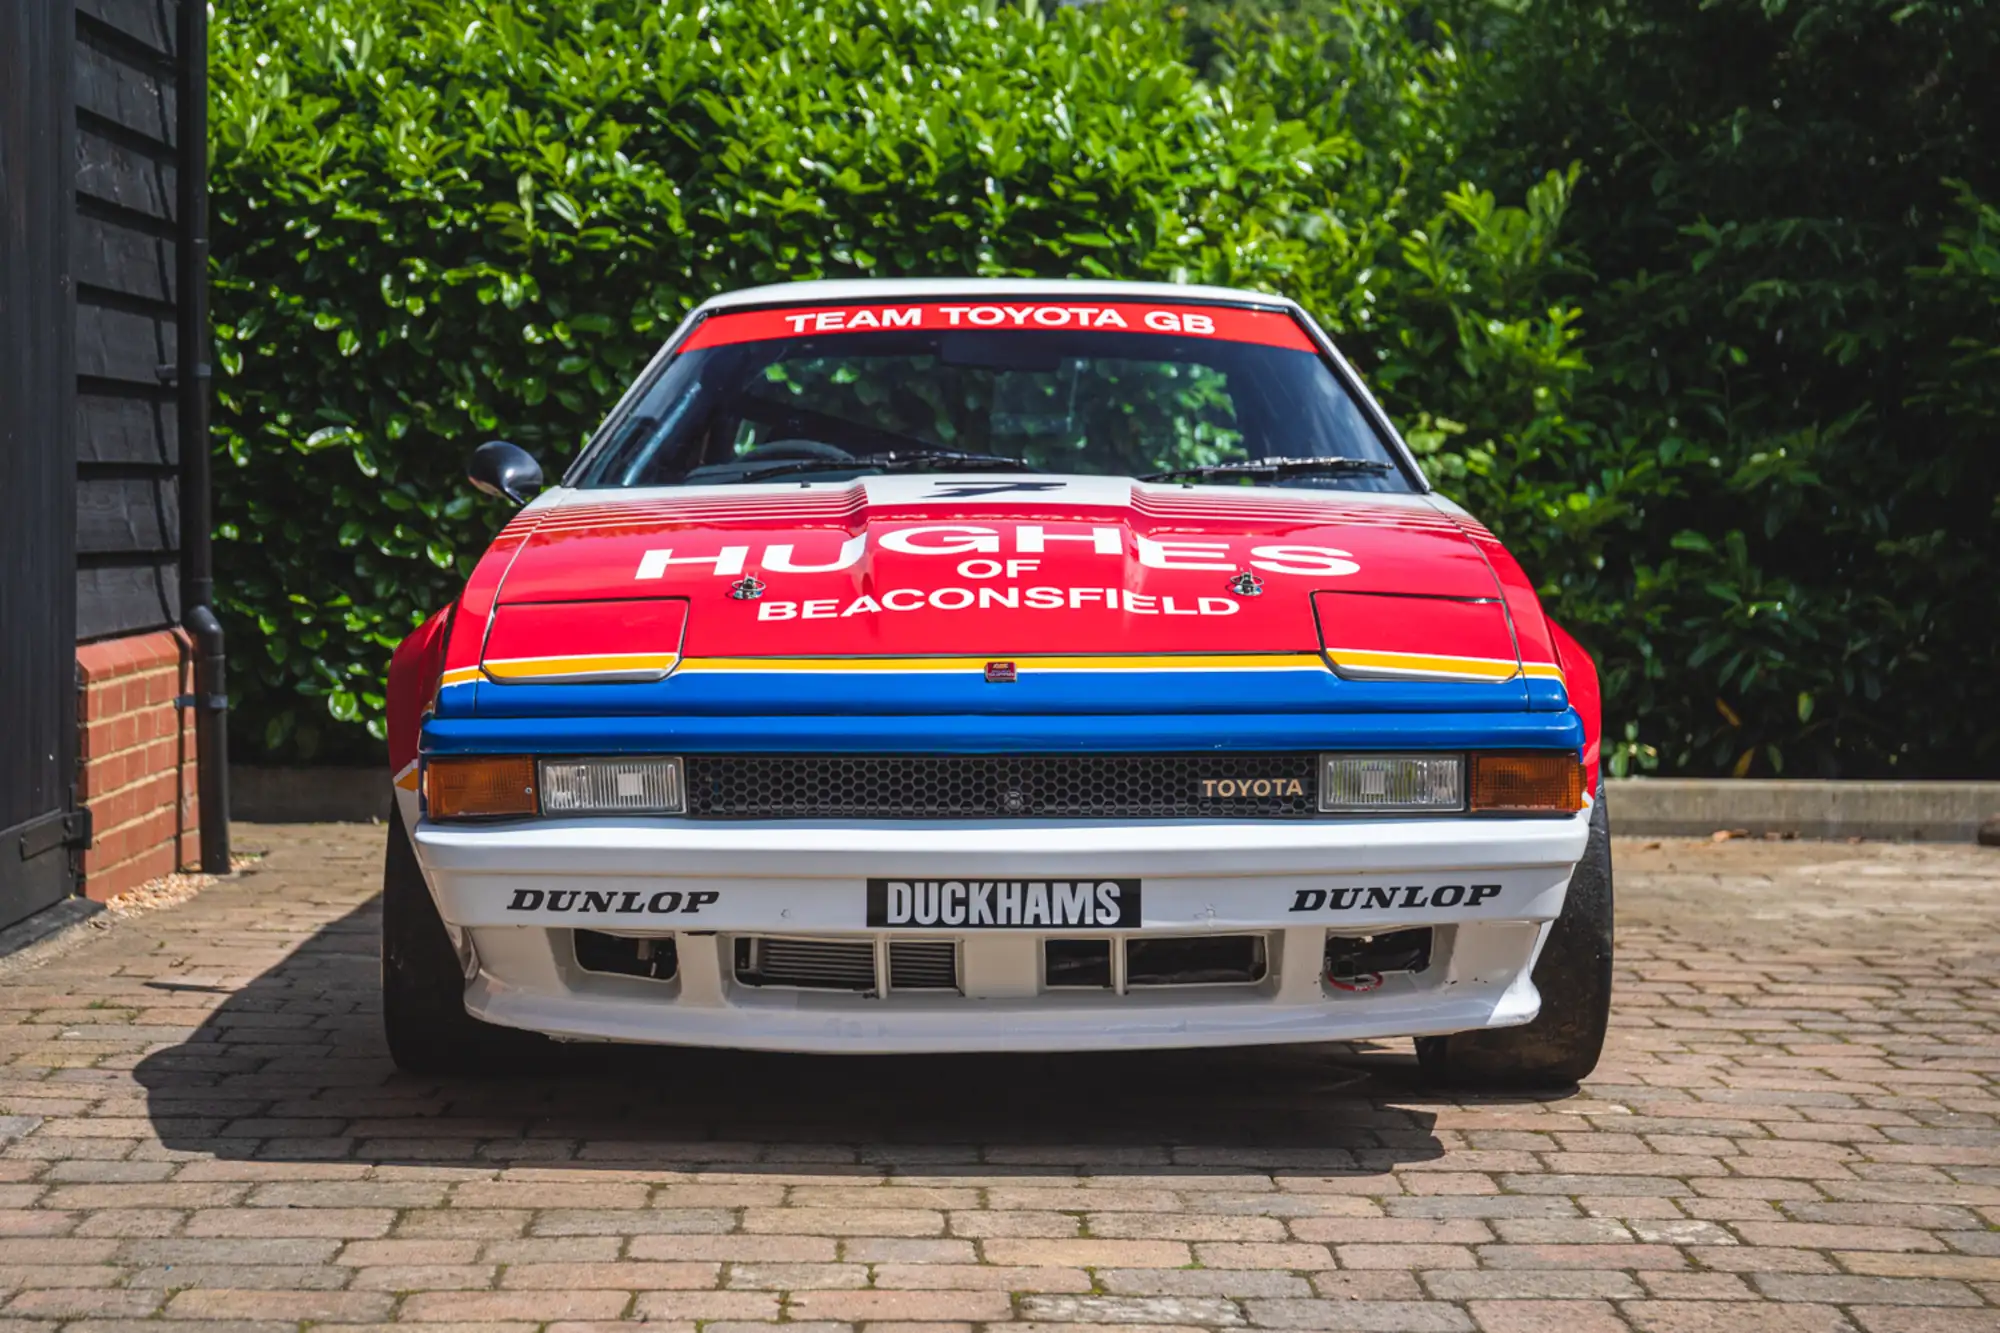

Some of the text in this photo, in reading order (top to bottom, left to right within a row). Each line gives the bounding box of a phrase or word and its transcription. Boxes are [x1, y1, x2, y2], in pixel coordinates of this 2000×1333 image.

[785, 306, 1216, 335] TEAM TOYOTA GB
[634, 524, 1361, 581] HUGHES
[956, 559, 1040, 579] OF
[757, 586, 1240, 622] BEACONSFIELD
[1202, 779, 1303, 797] TOYOTA
[506, 888, 720, 914] DUNLOP
[887, 881, 1122, 925] DUCKHAMS
[1288, 884, 1503, 913] DUNLOP
